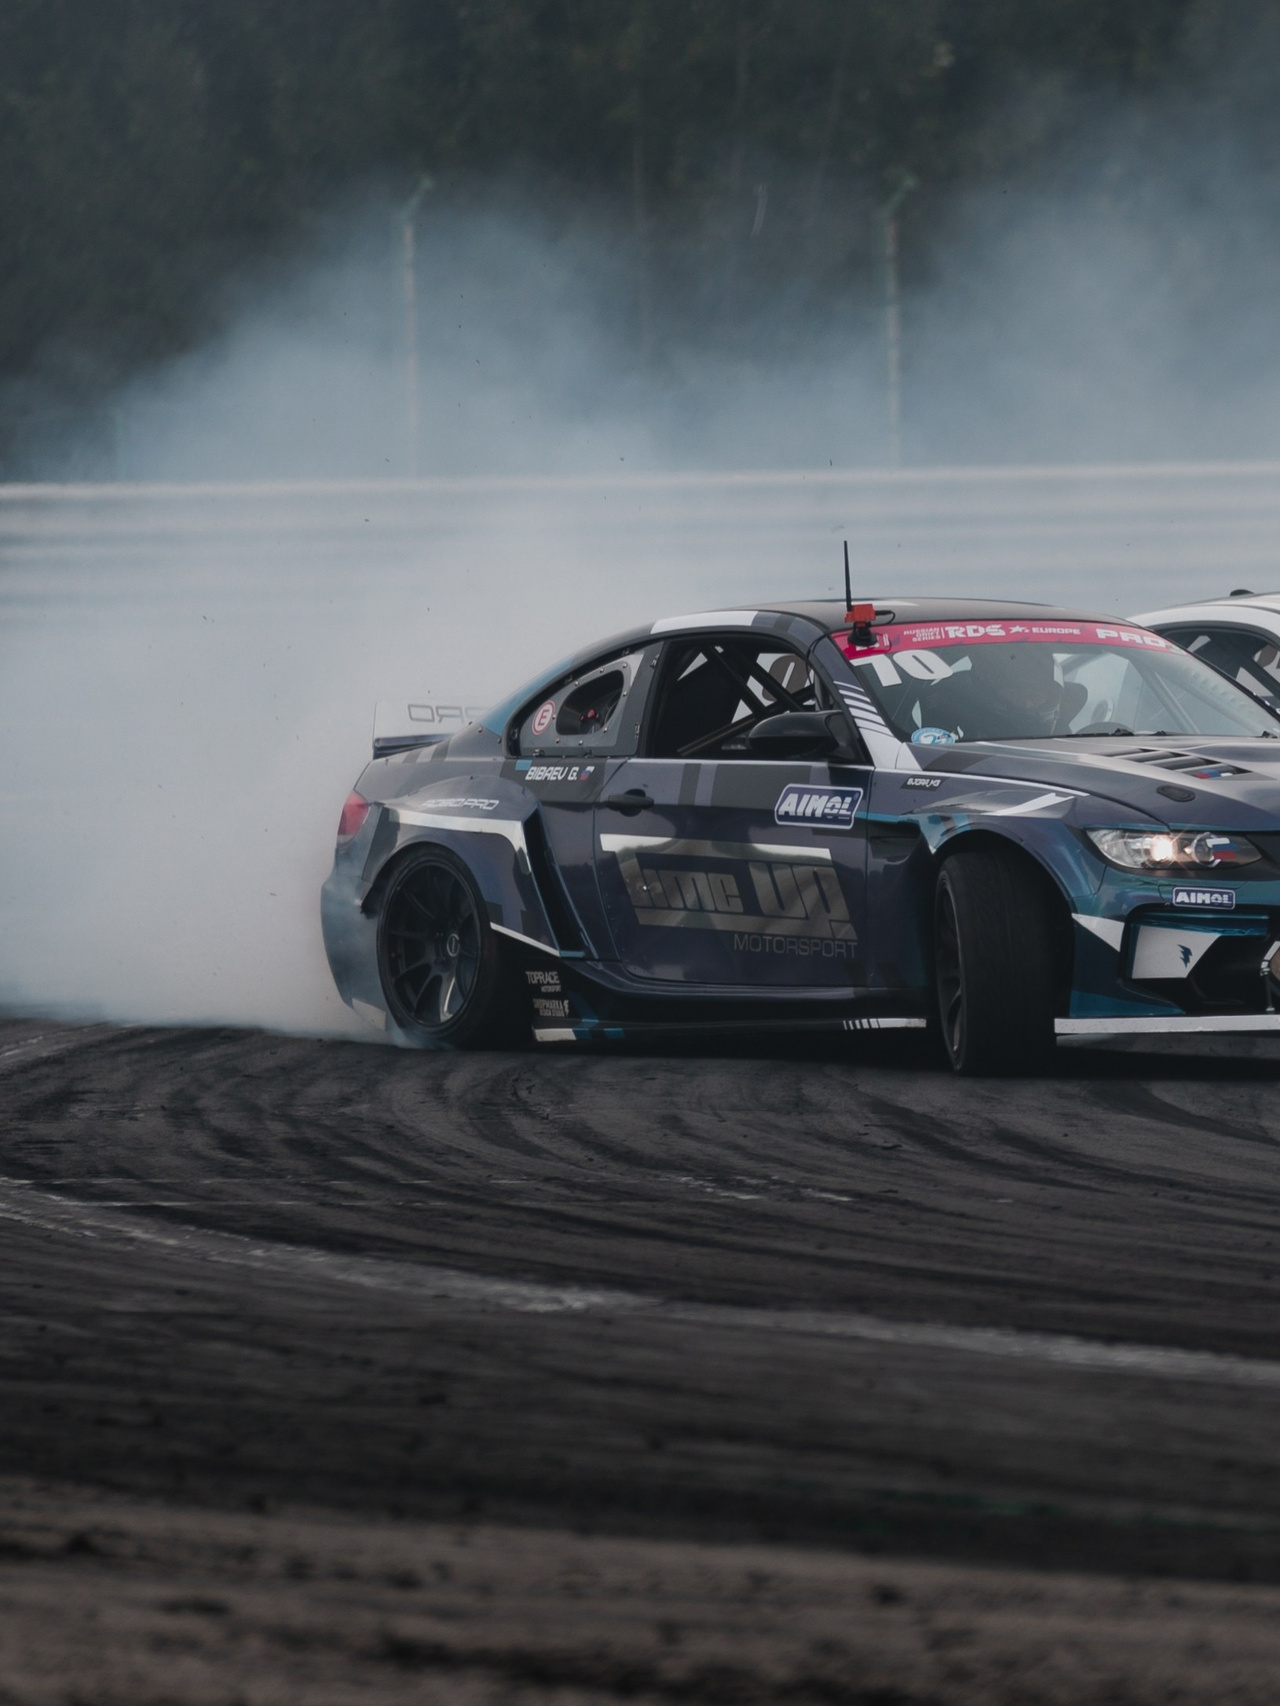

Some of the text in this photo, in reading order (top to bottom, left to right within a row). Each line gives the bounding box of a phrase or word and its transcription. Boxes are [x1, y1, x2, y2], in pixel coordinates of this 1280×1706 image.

[945, 624, 1006, 639] RDS
[1095, 628, 1166, 648] PRO
[849, 649, 954, 687] 70
[525, 766, 580, 781] BIBAEV G.
[778, 792, 853, 819] AIMOL
[1176, 891, 1233, 905] AIMOL
[734, 933, 858, 959] MOTORSPORT
